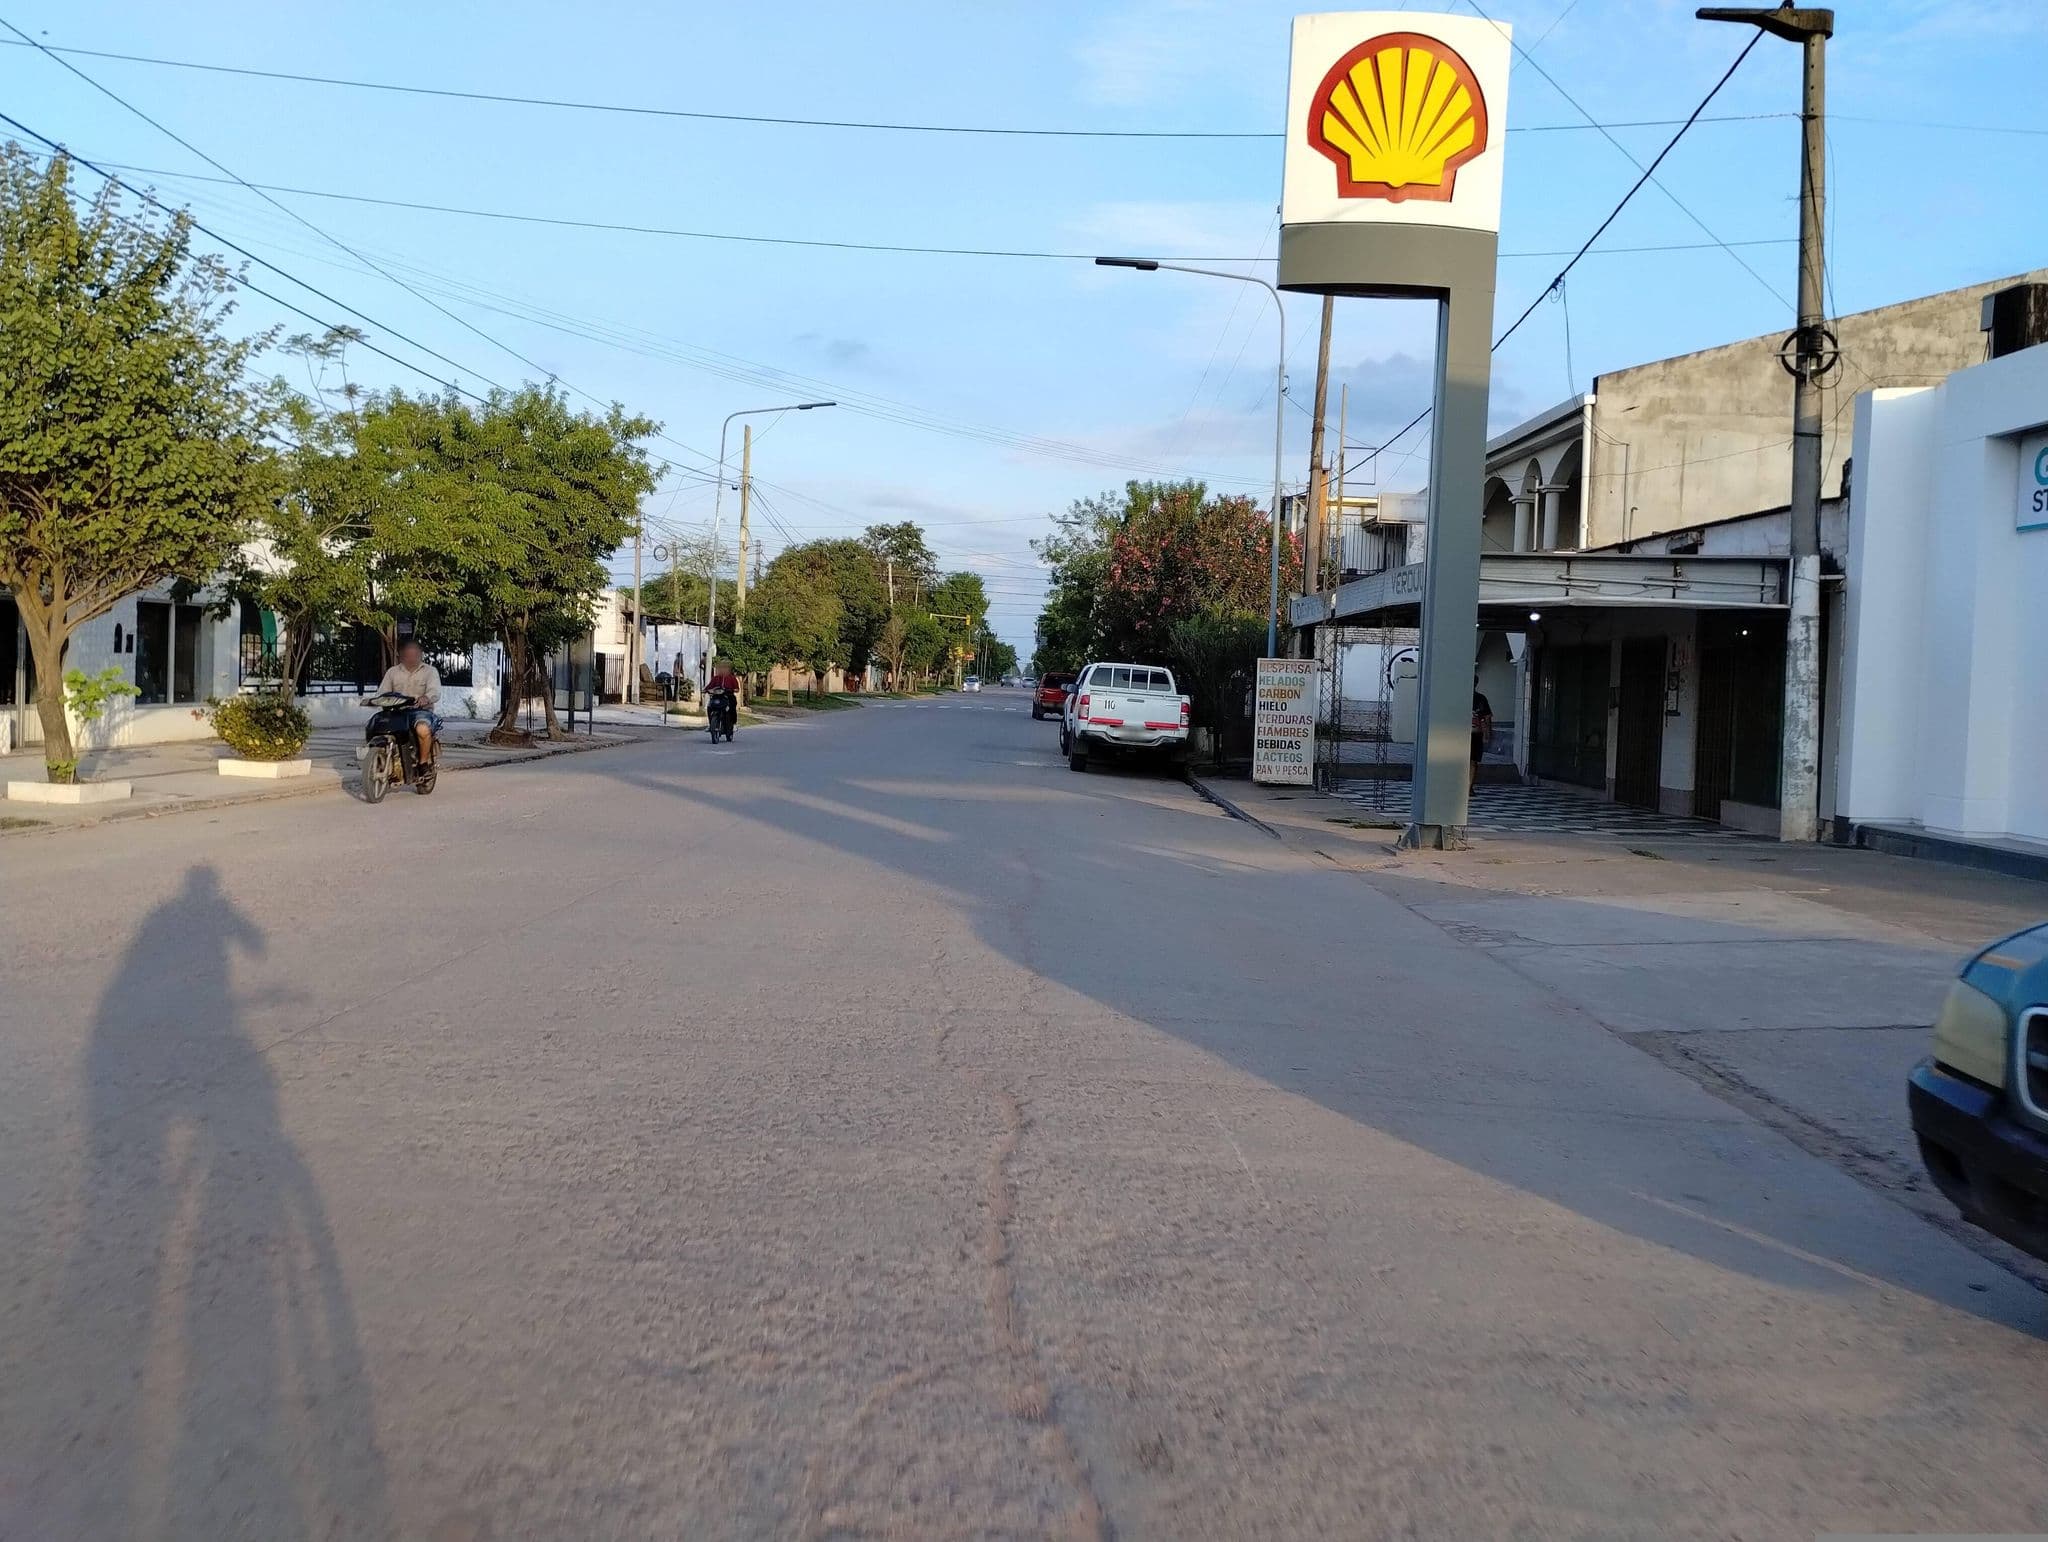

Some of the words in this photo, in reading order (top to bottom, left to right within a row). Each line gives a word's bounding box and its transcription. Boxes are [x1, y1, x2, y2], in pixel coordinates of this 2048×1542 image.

[1259, 662, 1312, 675] DESPENSA
[1259, 675, 1306, 687] HELADOS
[1258, 688, 1301, 700] CARBON
[1259, 701, 1288, 712] HIELO
[1258, 713, 1313, 726] VERDURAS
[1257, 739, 1301, 750] BEBIDAS
[1256, 752, 1303, 763] LACTEOS
[1256, 765, 1272, 775] PAN
[1275, 765, 1281, 775] Y
[1282, 765, 1308, 776] PESCA
